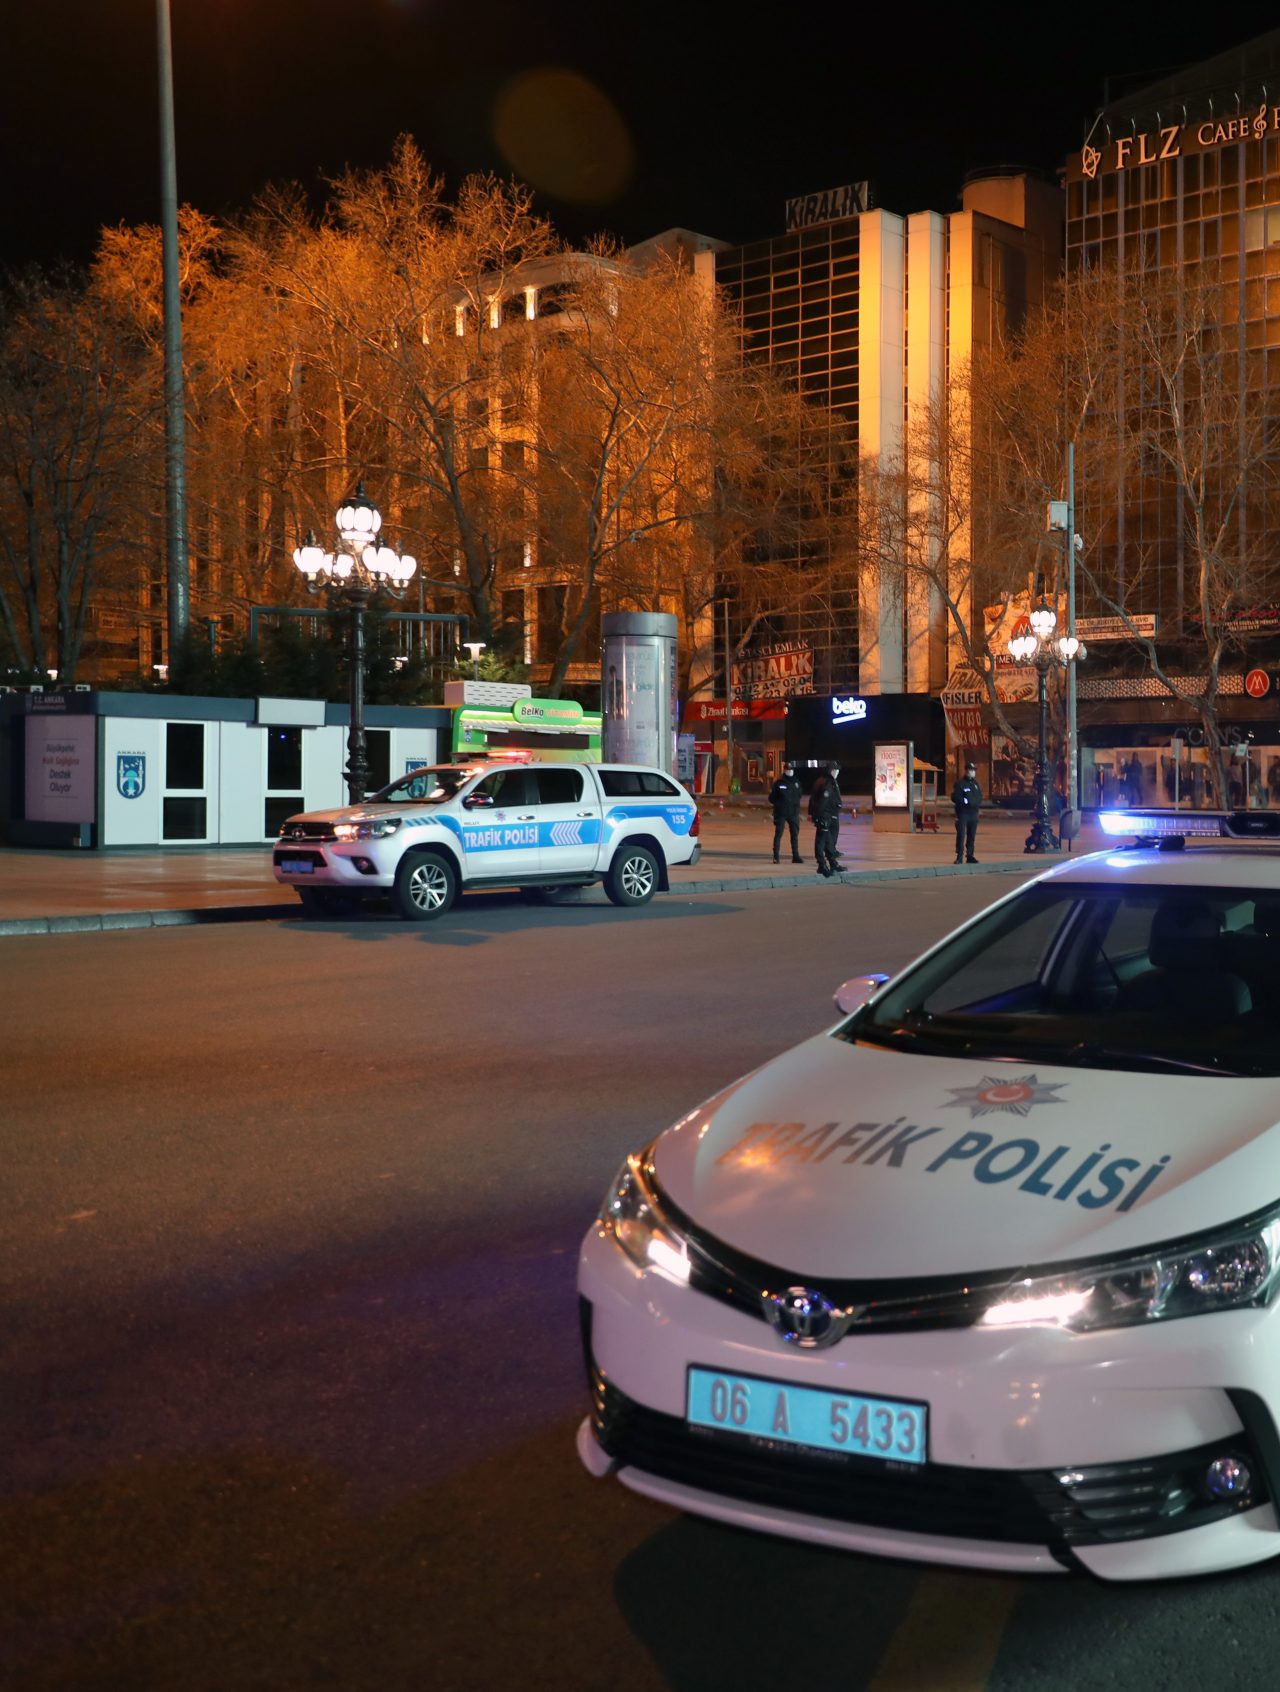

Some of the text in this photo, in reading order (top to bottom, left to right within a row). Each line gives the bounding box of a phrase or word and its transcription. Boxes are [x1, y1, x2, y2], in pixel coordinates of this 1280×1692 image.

[1115, 126, 1181, 169] FLZ
[1197, 118, 1249, 146] CAFE
[832, 697, 867, 715] beko
[463, 825, 539, 848] TRAFİK POLİSİ
[671, 814, 686, 824] 155
[714, 1116, 1172, 1213] TRAFİK POLİSİ
[710, 1378, 750, 1424] 06
[772, 1390, 791, 1436] A
[830, 1399, 917, 1456] 5433
